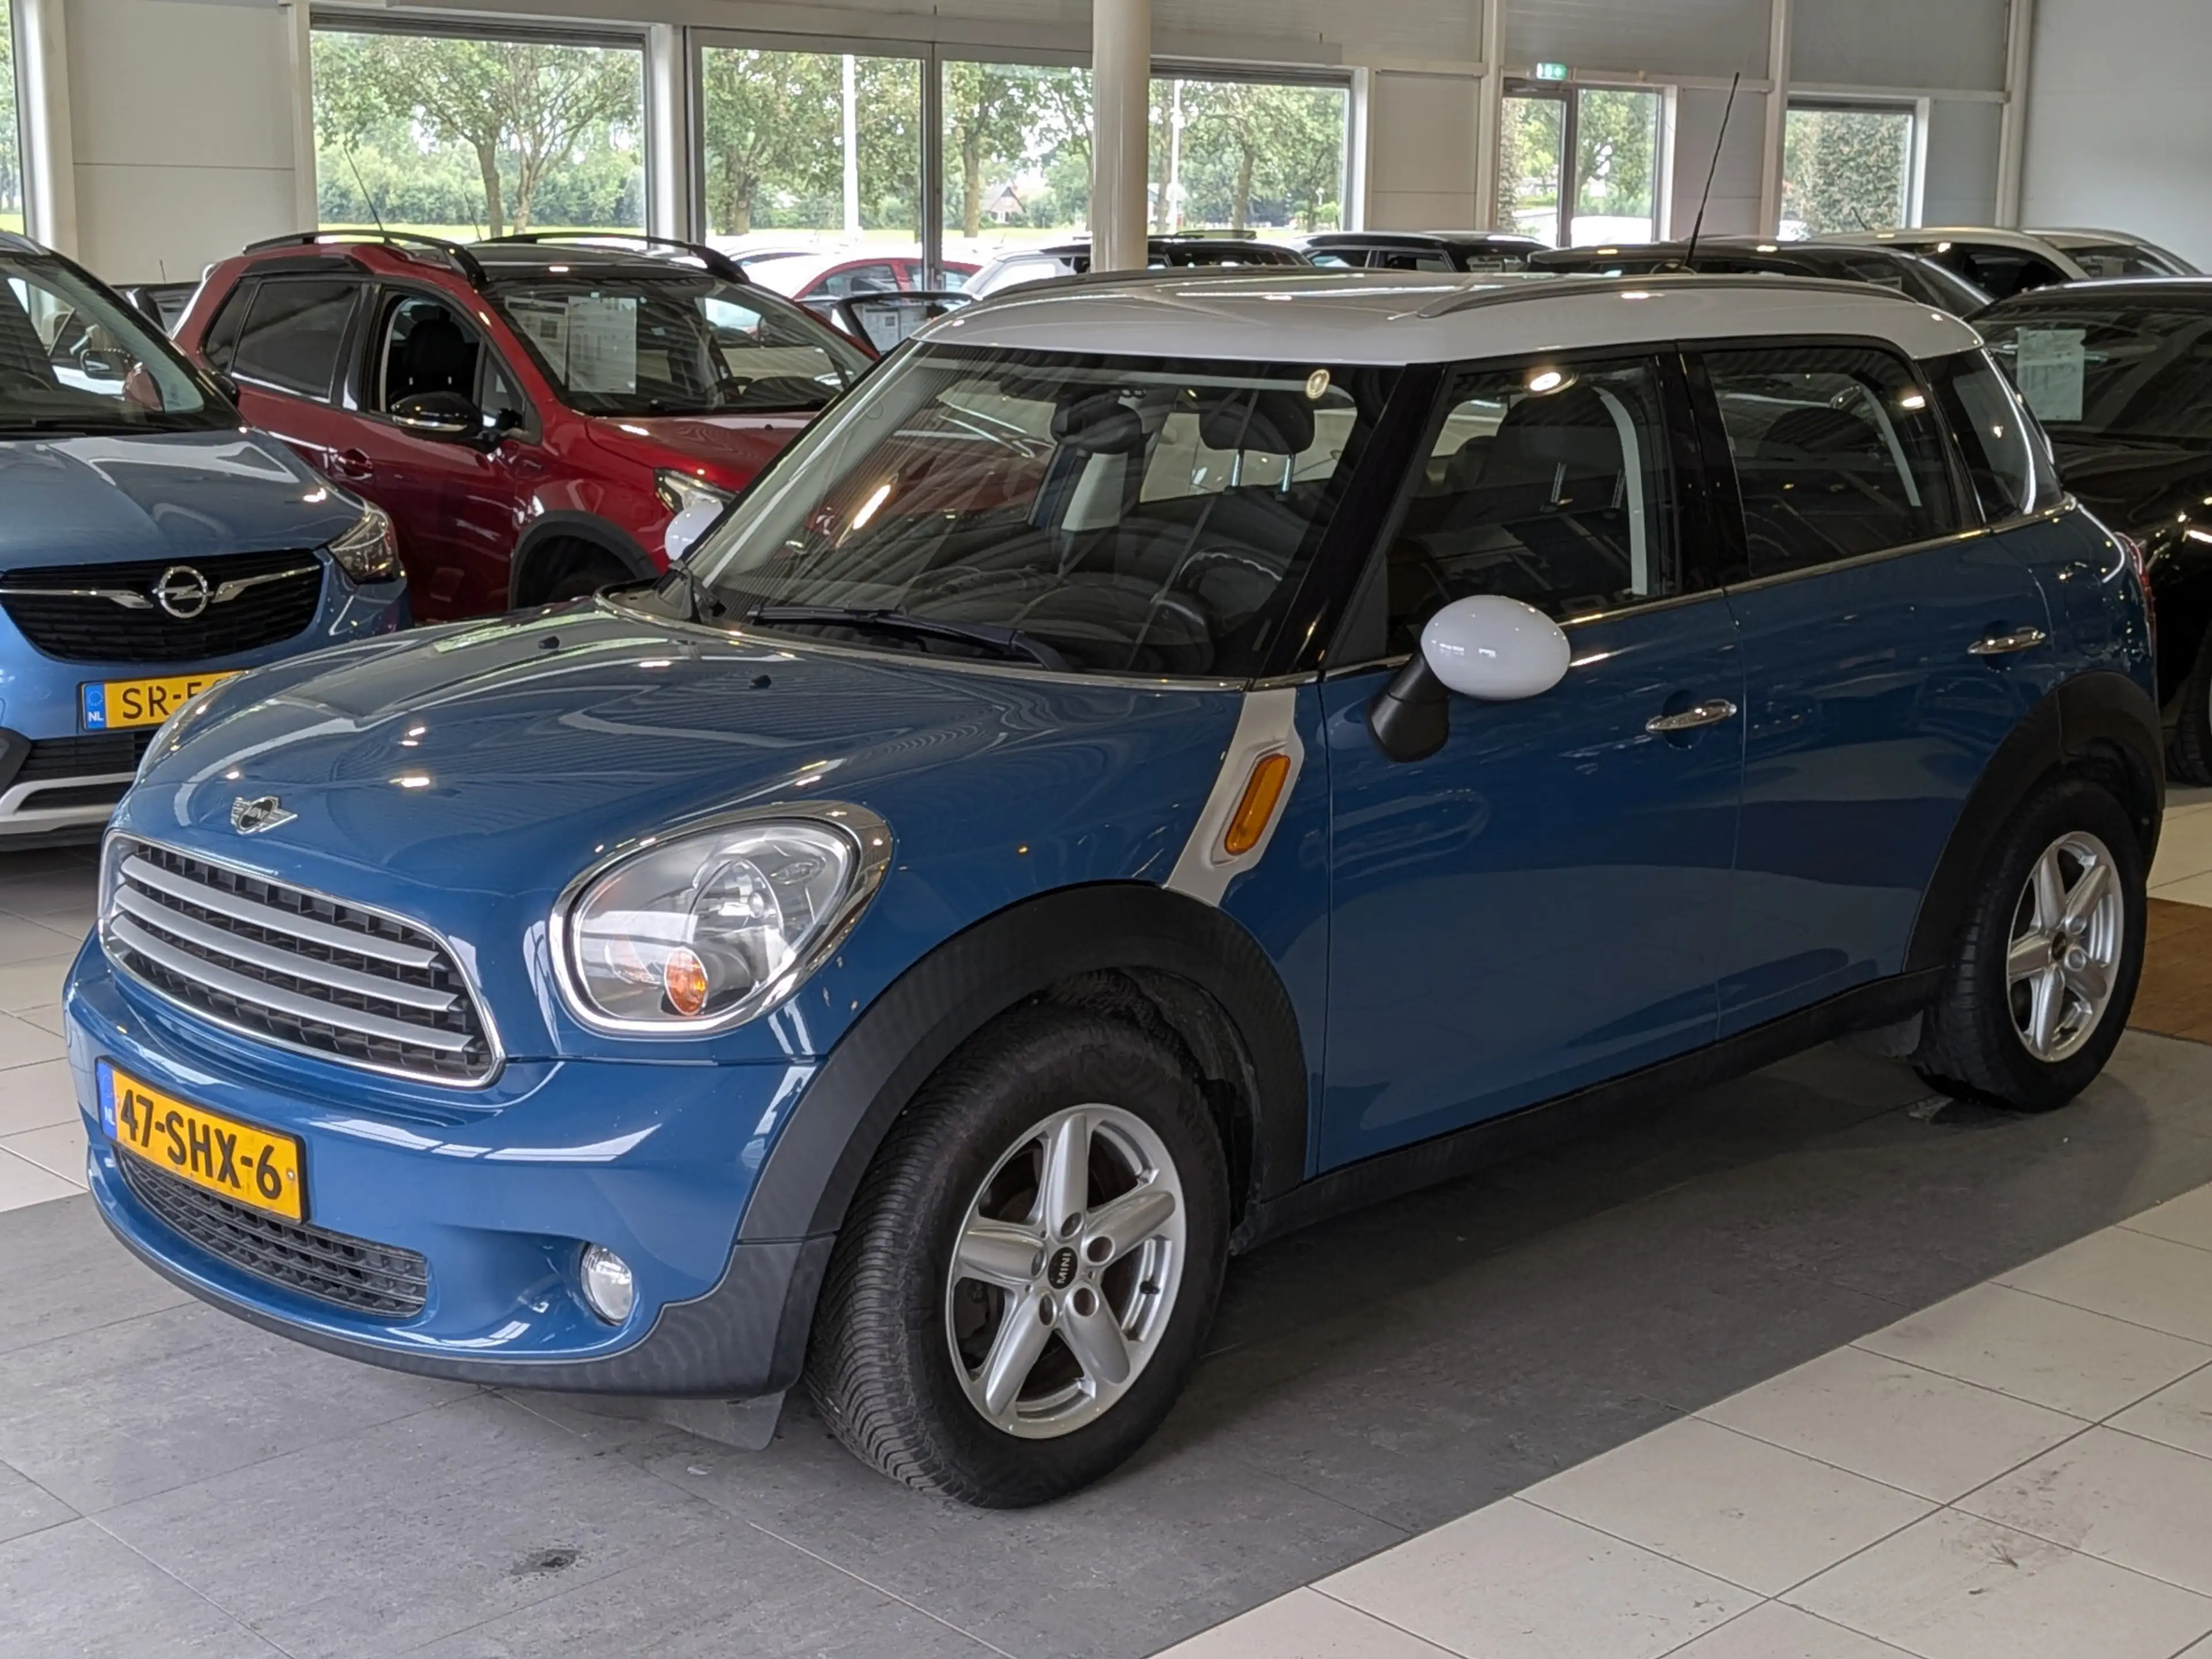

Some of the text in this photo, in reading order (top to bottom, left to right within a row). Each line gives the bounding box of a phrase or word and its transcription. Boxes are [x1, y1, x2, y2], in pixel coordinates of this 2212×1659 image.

[88, 711, 104, 722] NL
[104, 1105, 116, 1126] NL
[120, 1089, 282, 1200] 47-SHX-6
[1056, 1252, 1071, 1284] MINI
